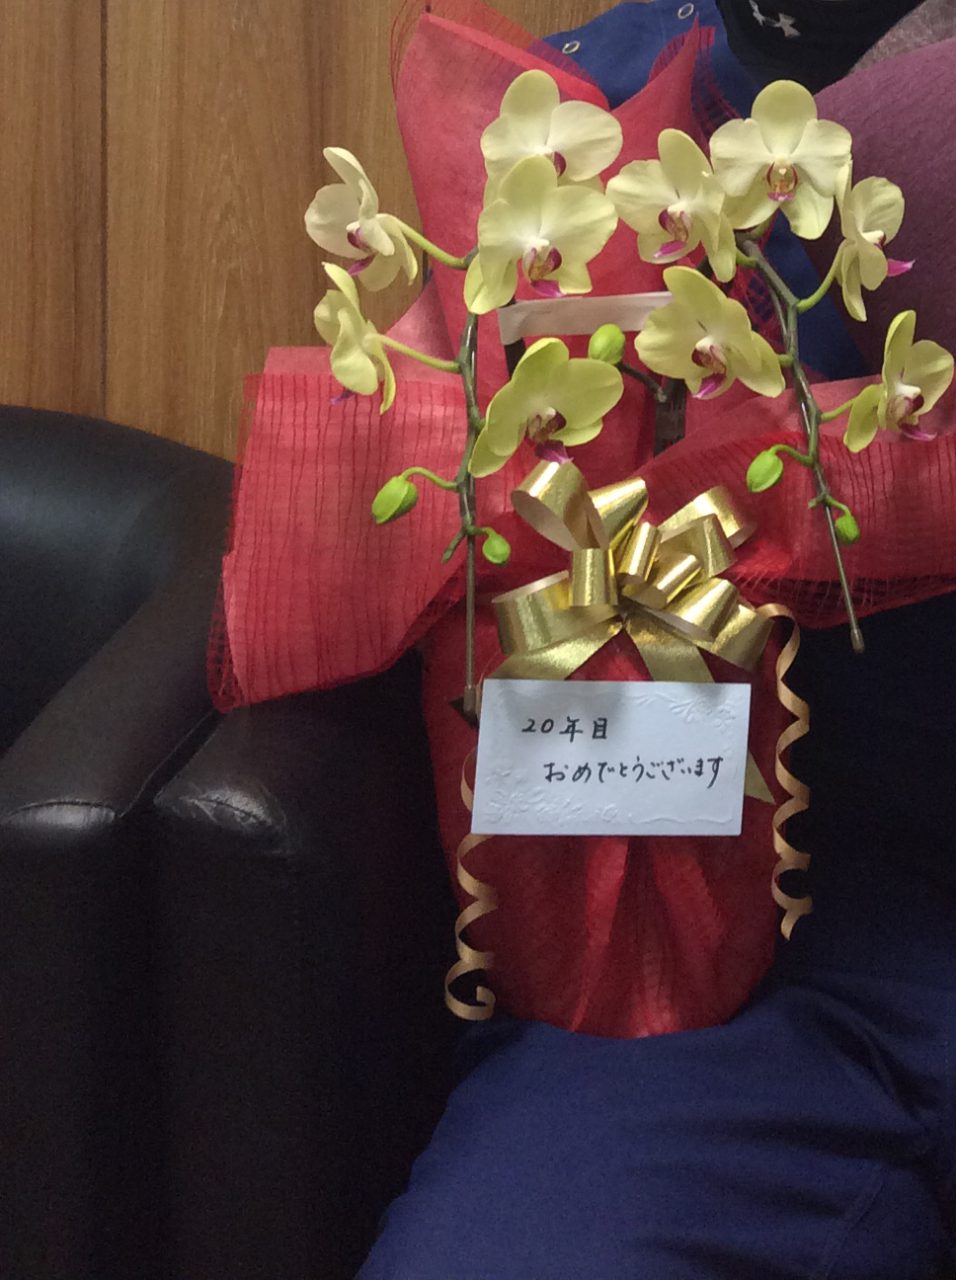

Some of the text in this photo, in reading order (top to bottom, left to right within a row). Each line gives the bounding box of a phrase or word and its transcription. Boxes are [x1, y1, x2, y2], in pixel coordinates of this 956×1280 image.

[521, 716, 608, 743] 20年目
[543, 756, 724, 789] おめでとうございます
